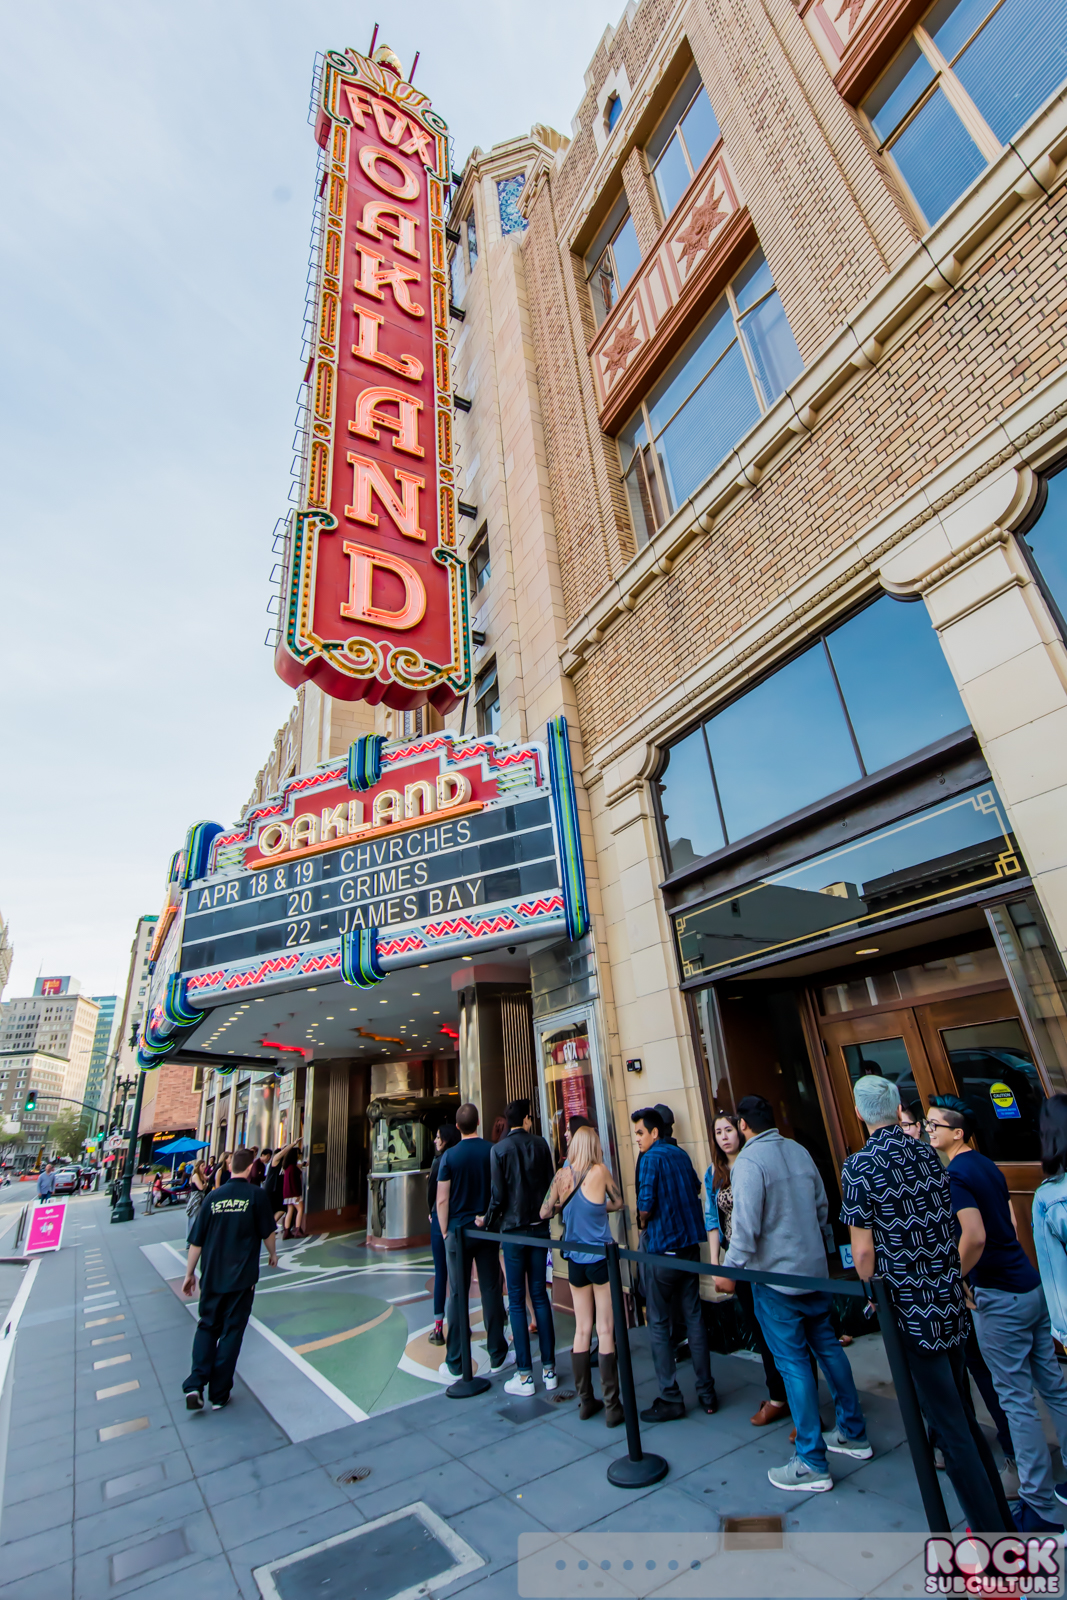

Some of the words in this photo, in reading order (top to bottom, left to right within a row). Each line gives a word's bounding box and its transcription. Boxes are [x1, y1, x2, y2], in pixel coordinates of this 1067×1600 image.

[343, 84, 432, 166] FOX
[339, 144, 427, 630] OAKLAND
[258, 771, 472, 857] OAKLAND
[198, 880, 240, 910] APR
[249, 873, 268, 896] 18
[274, 869, 287, 891] &
[294, 861, 314, 886] 19
[339, 819, 472, 874] CHVRCHES
[288, 890, 312, 918] 20
[338, 860, 429, 905] GRIMES
[286, 920, 311, 948] 22
[338, 896, 419, 935] JAMES
[429, 879, 482, 915] BAY
[215, 1199, 245, 1210] STAFF
